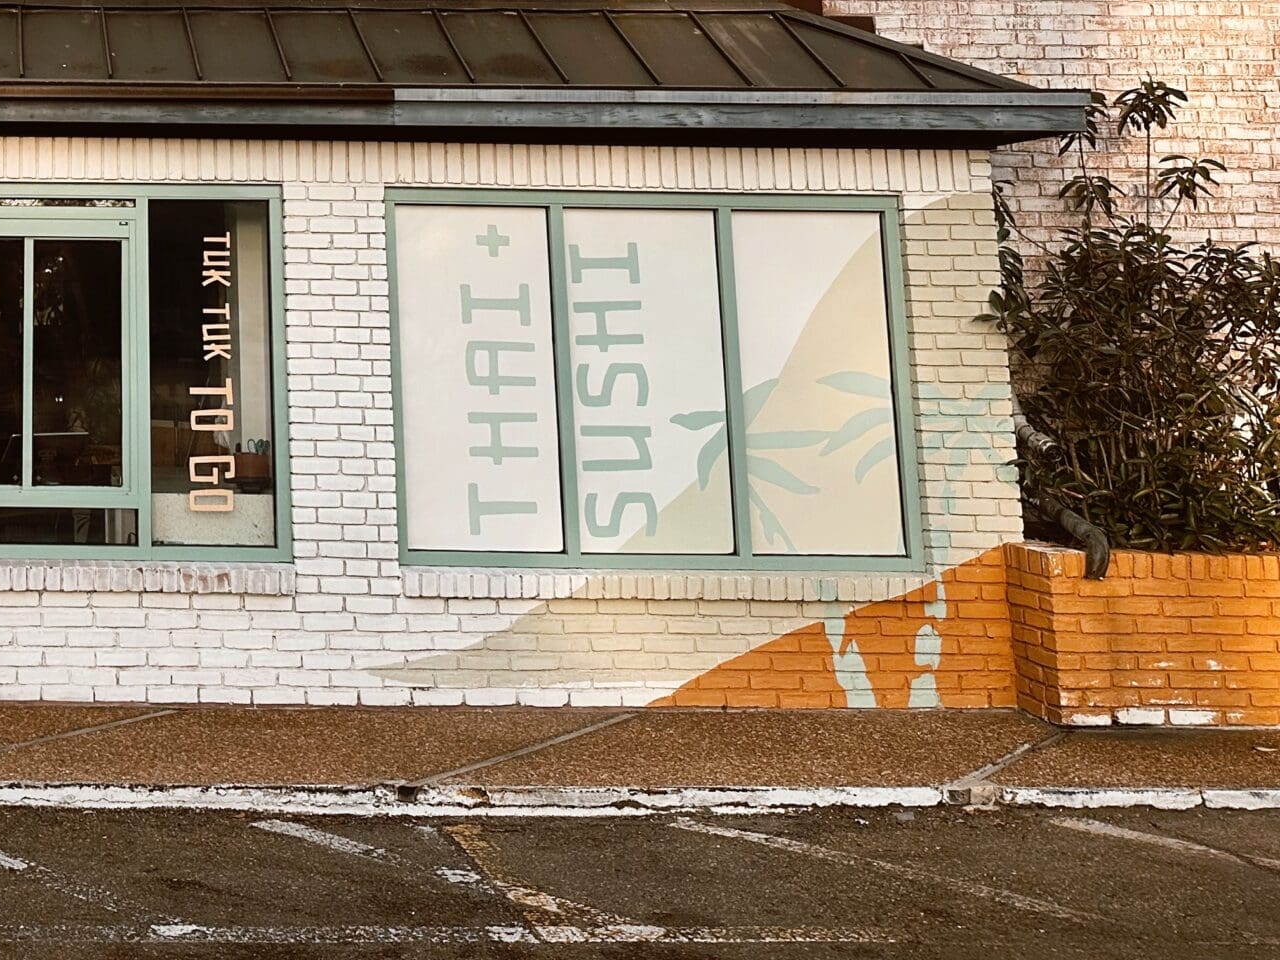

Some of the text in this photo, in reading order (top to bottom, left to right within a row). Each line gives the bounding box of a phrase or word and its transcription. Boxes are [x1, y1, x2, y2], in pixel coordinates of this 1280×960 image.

[189, 231, 236, 513] TUK TUK TO GO
[460, 283, 539, 536] THAI
[568, 242, 658, 538] SUSHI
